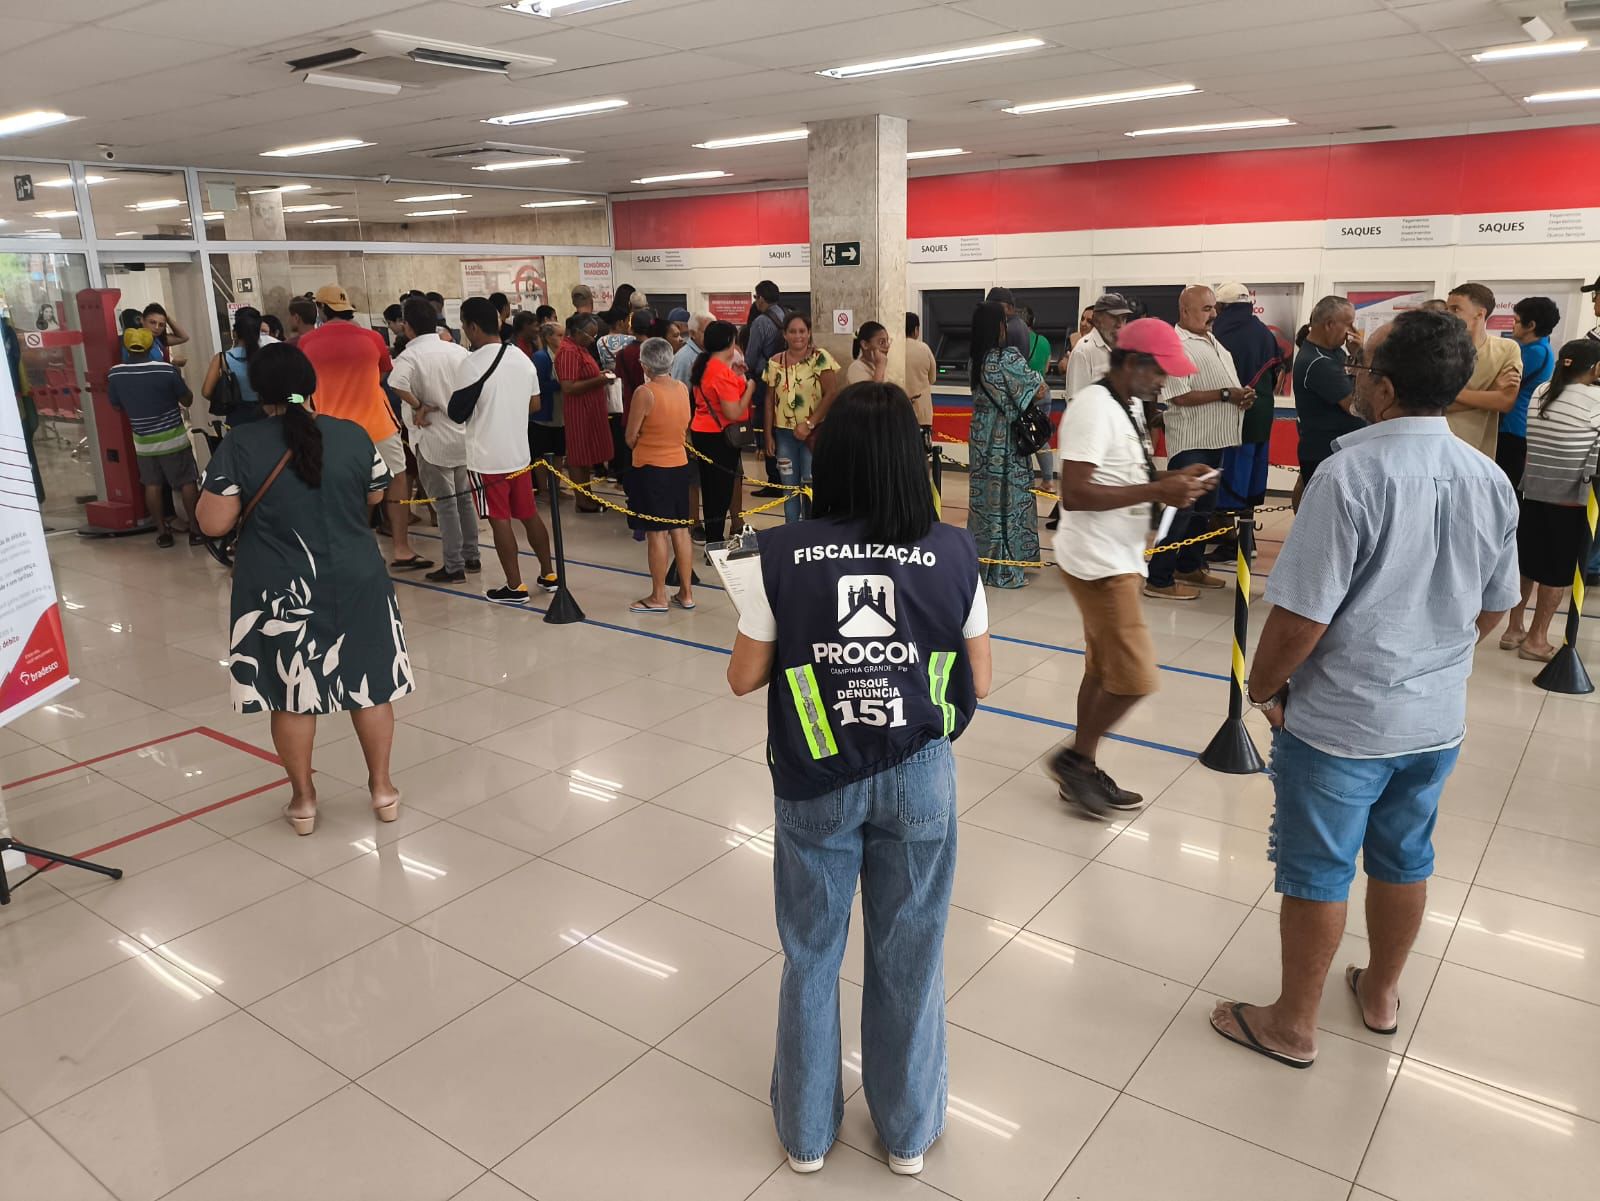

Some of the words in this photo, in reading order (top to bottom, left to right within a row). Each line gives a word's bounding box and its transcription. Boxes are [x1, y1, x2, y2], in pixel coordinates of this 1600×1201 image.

[1341, 226, 1382, 237] SAQUES
[1478, 221, 1525, 233] SAQUES
[921, 244, 948, 254] SAQUES
[636, 255, 661, 263] SAQUES
[768, 251, 791, 260] SAQUES
[583, 260, 610, 269] CONSÓRCIO
[794, 543, 937, 567] FISCALIZAÇÃO
[811, 641, 920, 665] PROCON
[30, 661, 59, 682] bradesco
[830, 666, 862, 675] CAMPINA
[864, 665, 893, 673] GRANDE
[848, 677, 889, 689] DISQUE
[836, 685, 901, 700] DENÚNCIA
[832, 698, 908, 728] 151
